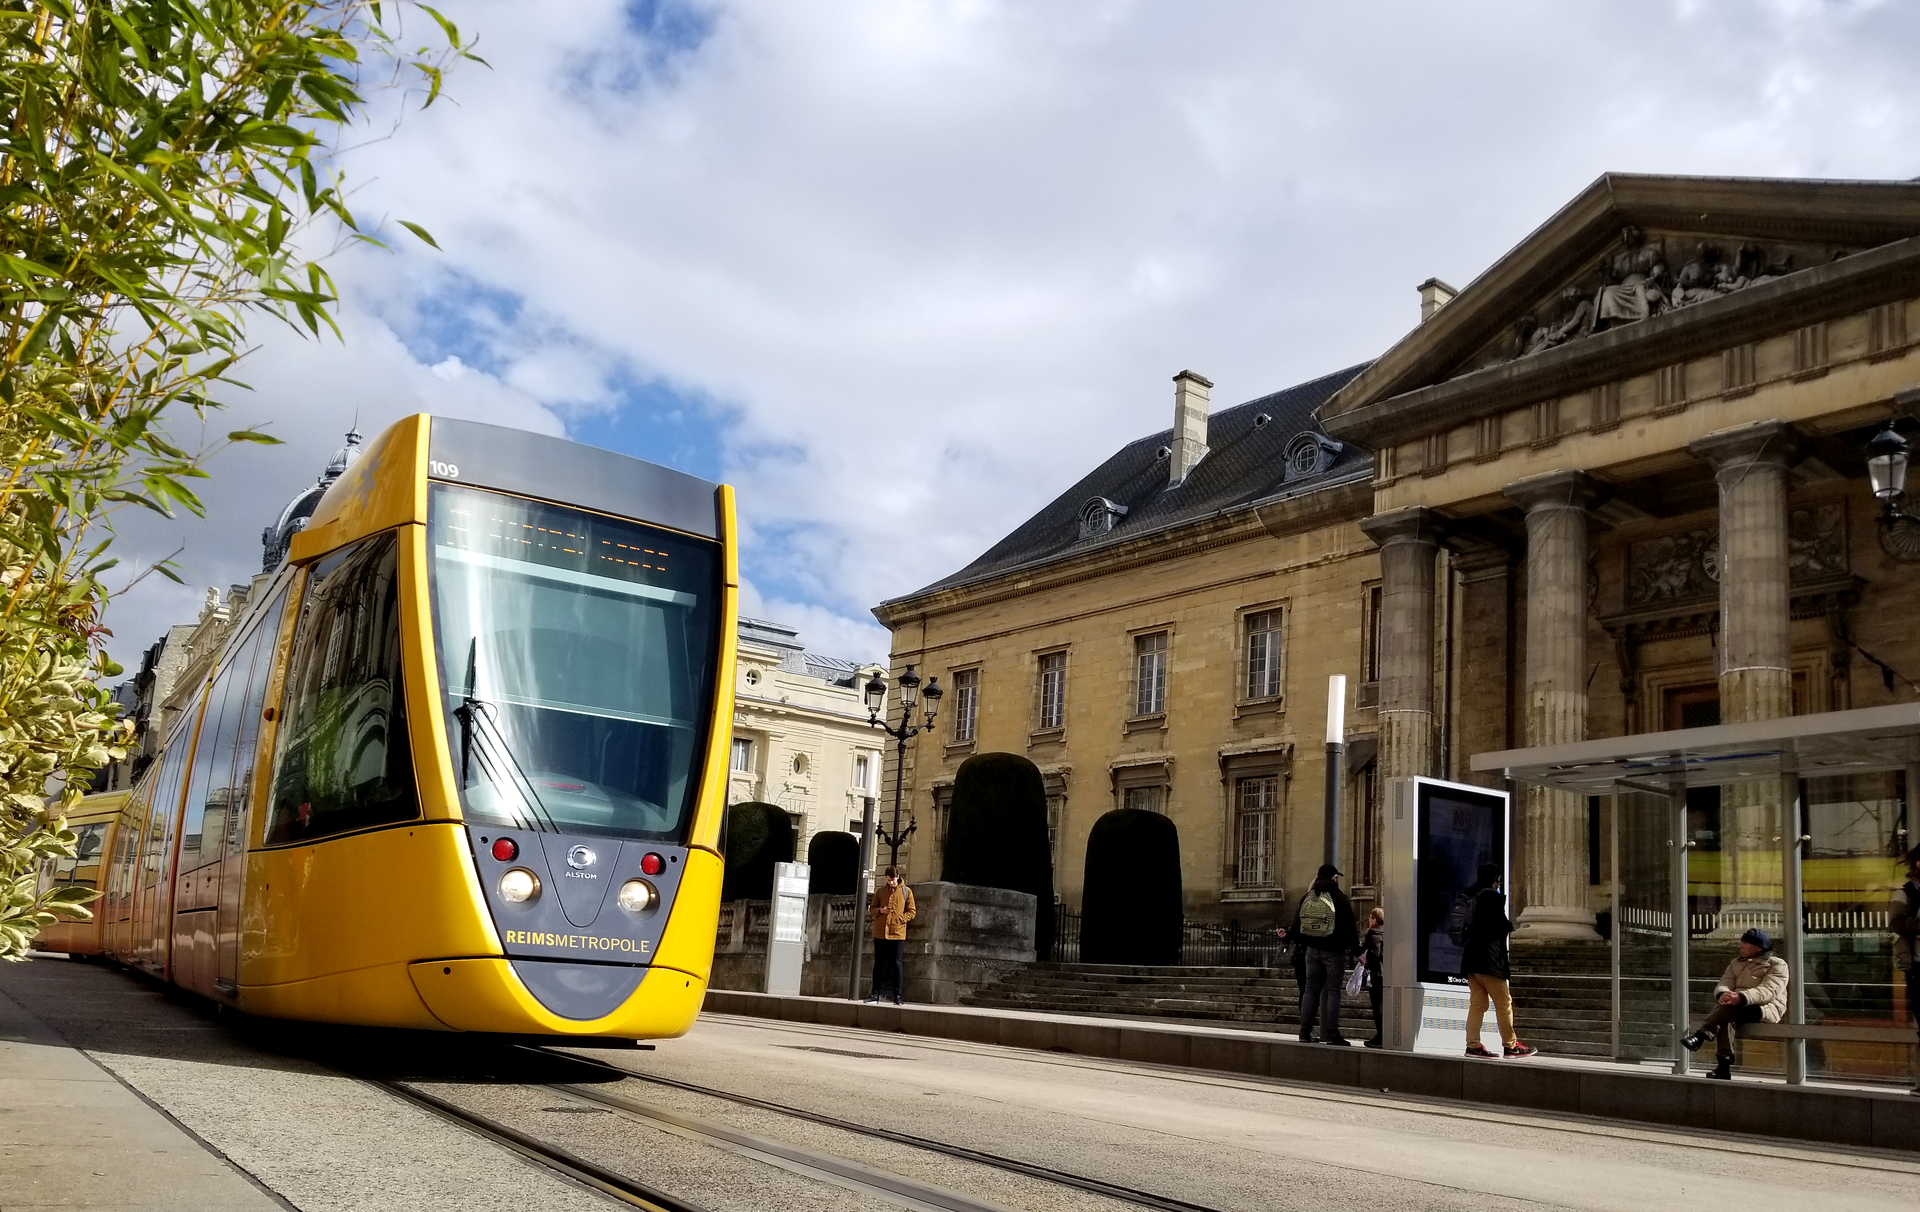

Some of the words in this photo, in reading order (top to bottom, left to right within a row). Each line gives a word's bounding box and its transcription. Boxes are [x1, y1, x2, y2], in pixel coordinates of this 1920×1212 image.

[430, 460, 459, 478] 109
[565, 871, 597, 880] ALSTOM
[506, 930, 650, 953] REIMSMETROPOLE
